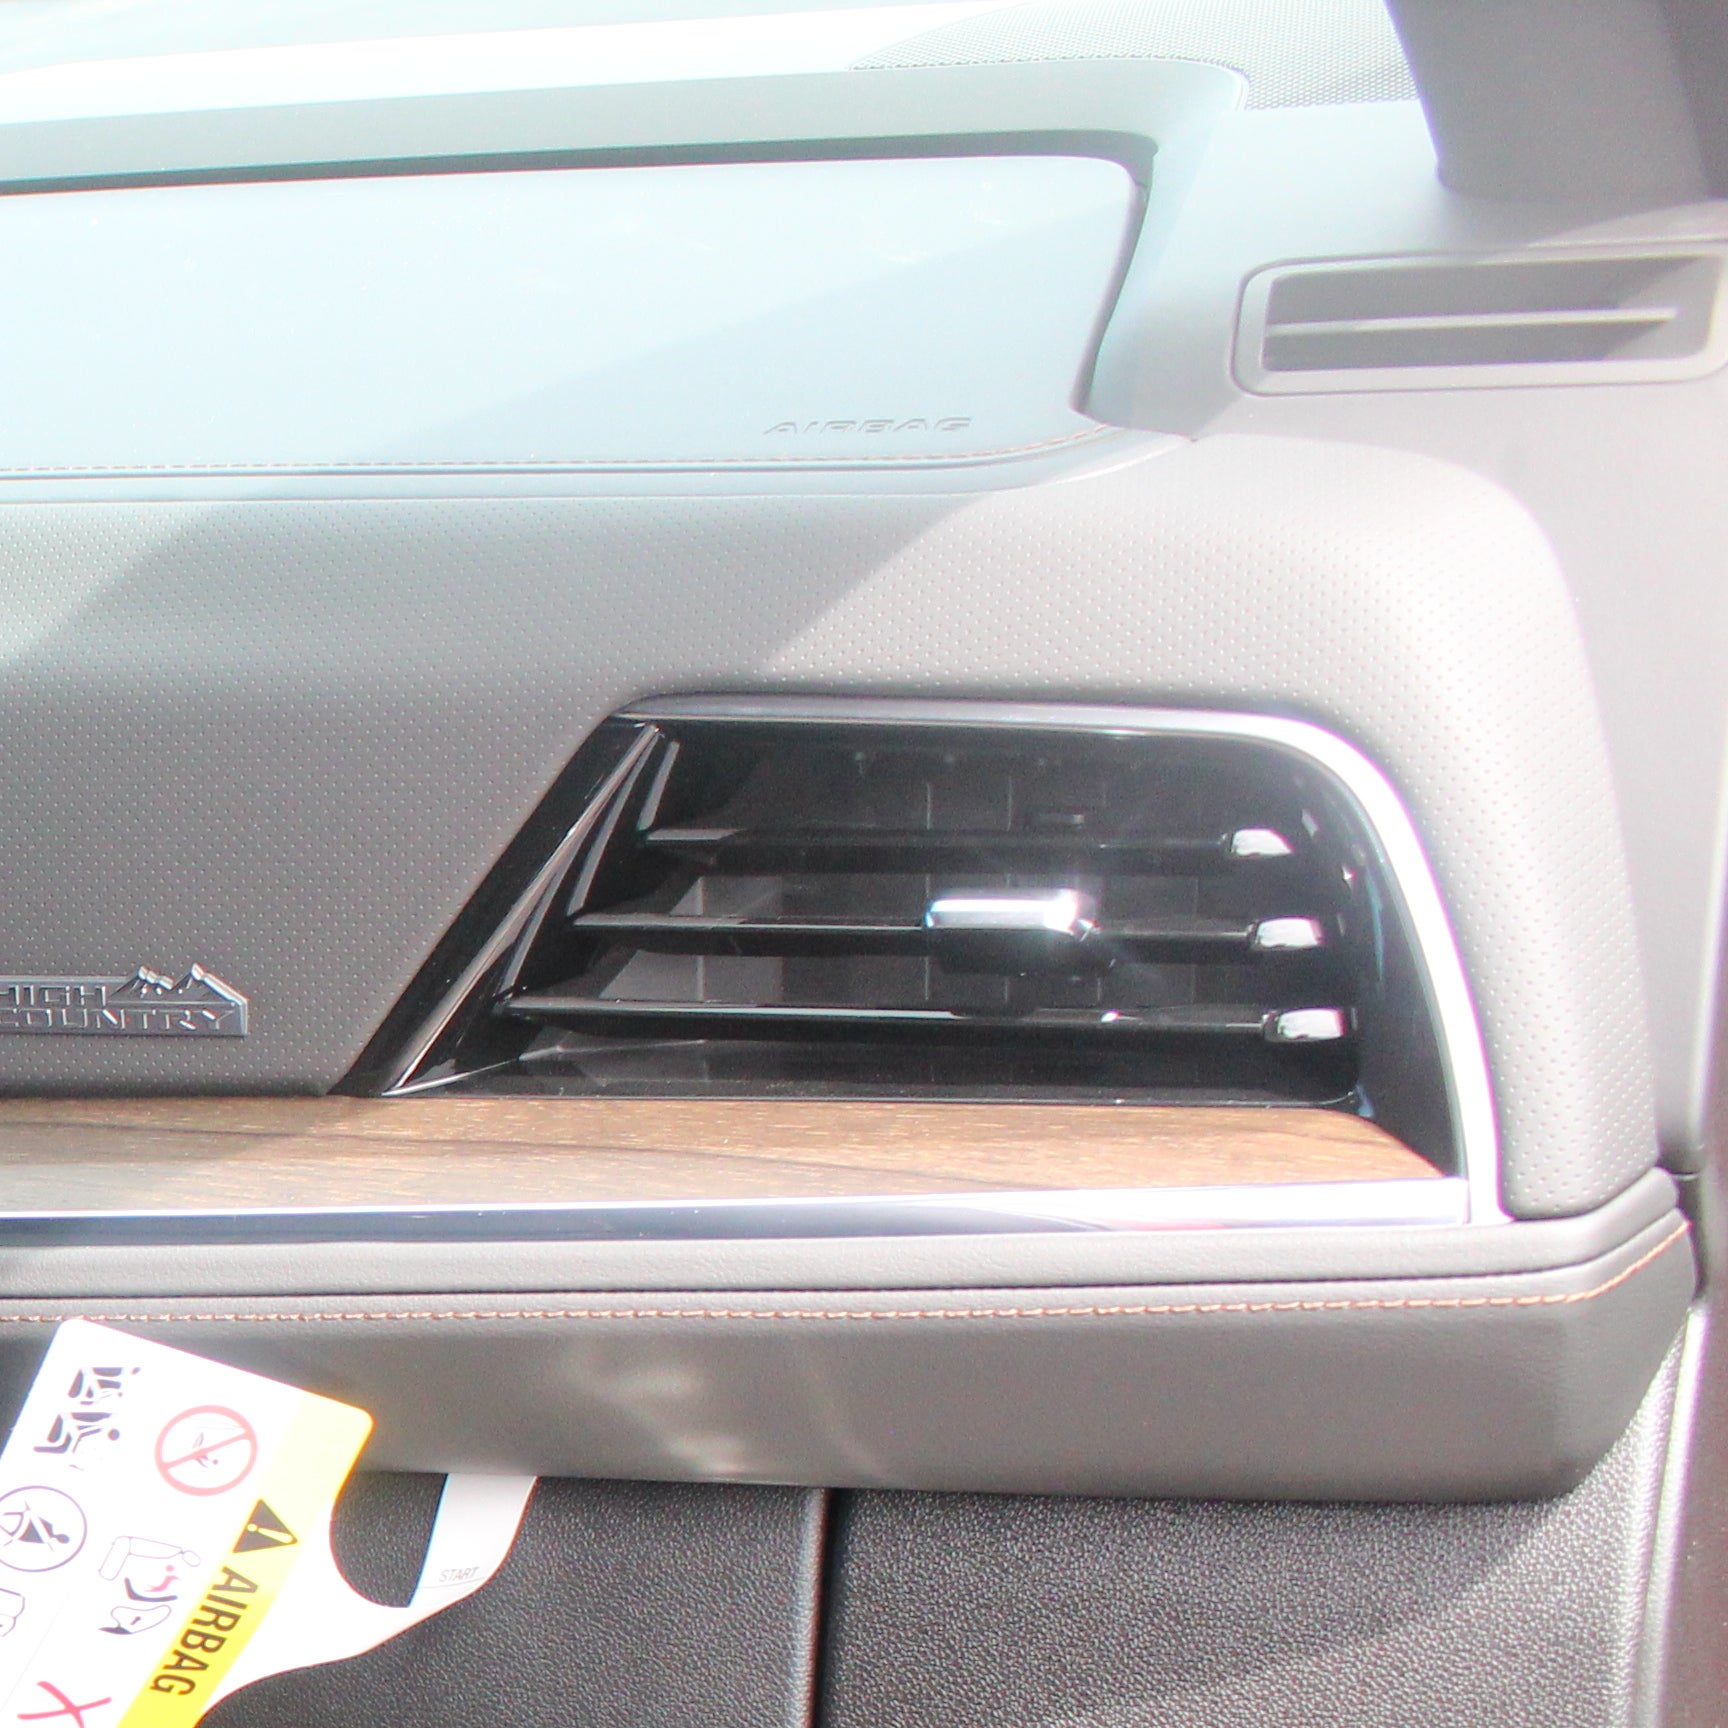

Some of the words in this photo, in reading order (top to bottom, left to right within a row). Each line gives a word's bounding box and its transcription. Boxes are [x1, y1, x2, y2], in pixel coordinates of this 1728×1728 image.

[763, 416, 972, 434] AIRBAG
[439, 1566, 480, 1582] START
[149, 1565, 259, 1696] AIRBAG
